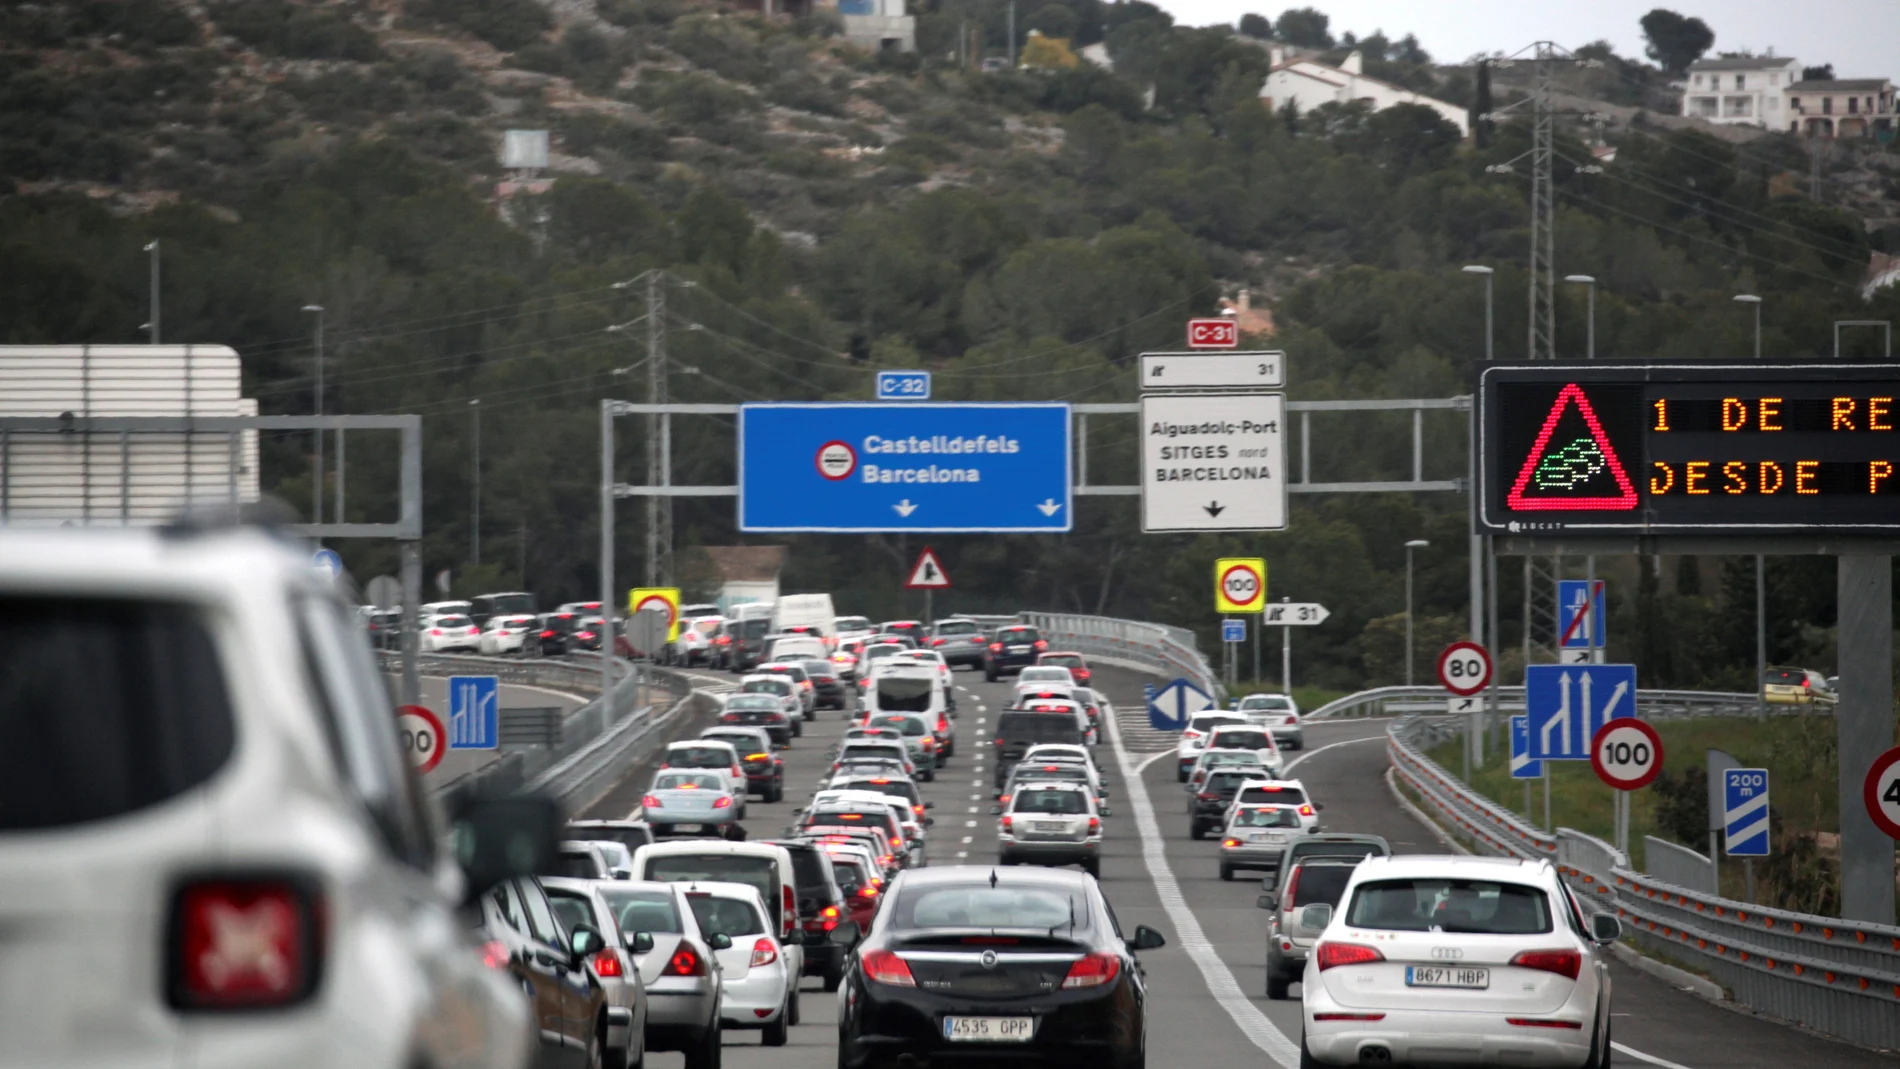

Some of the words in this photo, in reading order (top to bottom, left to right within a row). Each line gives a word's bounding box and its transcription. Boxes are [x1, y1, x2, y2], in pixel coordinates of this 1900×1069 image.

[1194, 325, 1233, 341] C-31
[1257, 363, 1275, 376] 31
[882, 378, 925, 393] C-32
[1654, 398, 1669, 431] 1
[1722, 398, 1782, 431] DE
[1832, 397, 1893, 431] RE
[1150, 420, 1277, 438] Aiguadolç-Port
[863, 435, 1020, 454] Castelldefels
[1160, 445, 1229, 460] SITGES
[862, 464, 981, 484] Barcelona
[1156, 466, 1271, 482] BARCELONA
[1650, 461, 1819, 494] DESDE
[1870, 461, 1893, 494] P
[1226, 578, 1256, 592] 100
[1297, 606, 1318, 621] 31
[1450, 659, 1480, 678] 80
[1605, 742, 1649, 766] 100
[1730, 774, 1763, 787] 200
[1740, 787, 1753, 797] m
[1416, 968, 1450, 983] 8671
[1457, 969, 1485, 984] HBP
[953, 1018, 989, 1034] 4535
[1000, 1019, 1028, 1034] GPP
